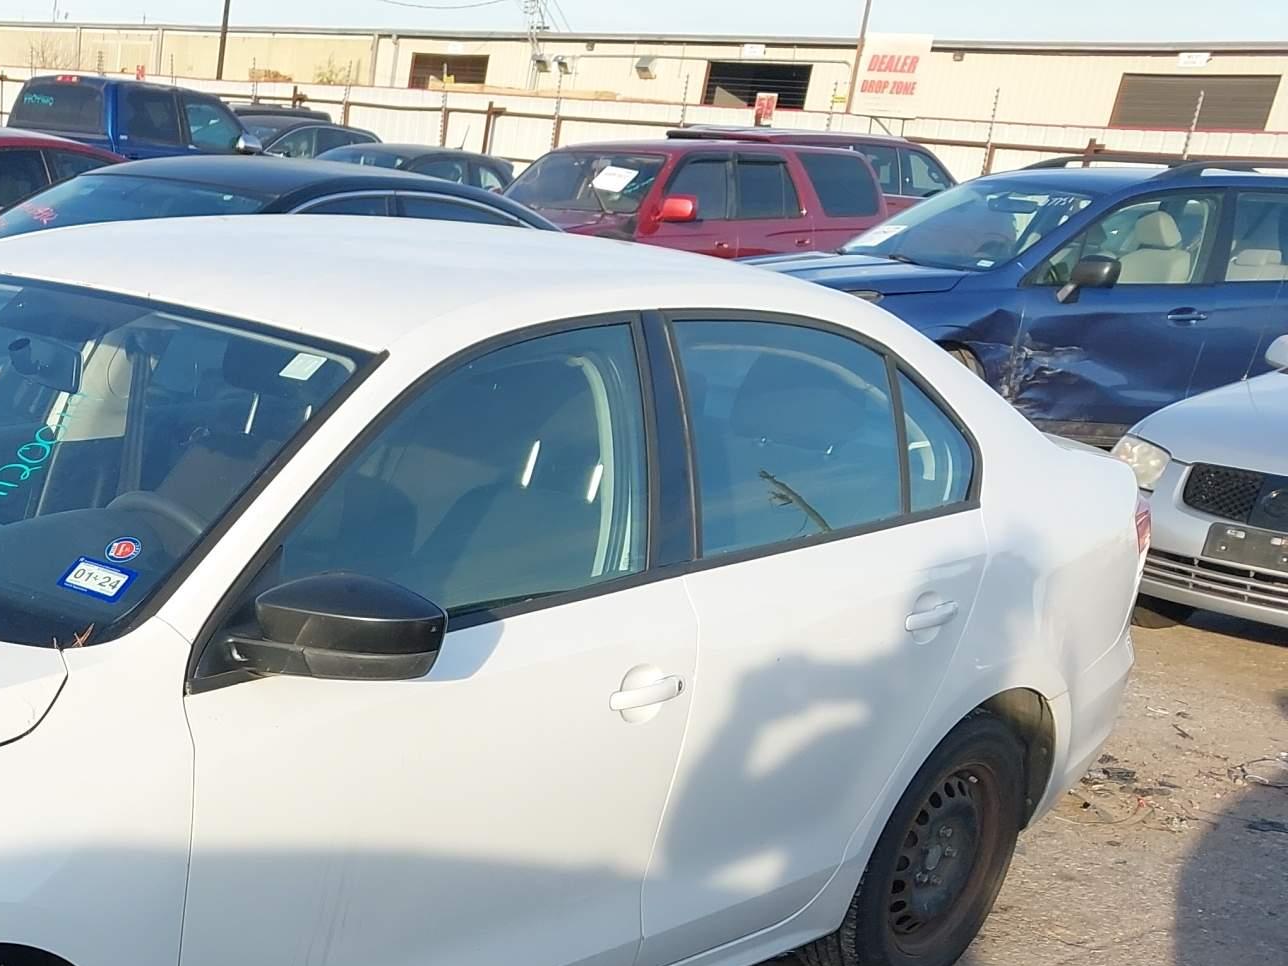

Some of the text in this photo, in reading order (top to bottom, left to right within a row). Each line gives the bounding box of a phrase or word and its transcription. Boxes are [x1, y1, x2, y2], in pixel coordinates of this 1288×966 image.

[867, 54, 920, 73] DEALER
[860, 79, 917, 95] DROP ZONE
